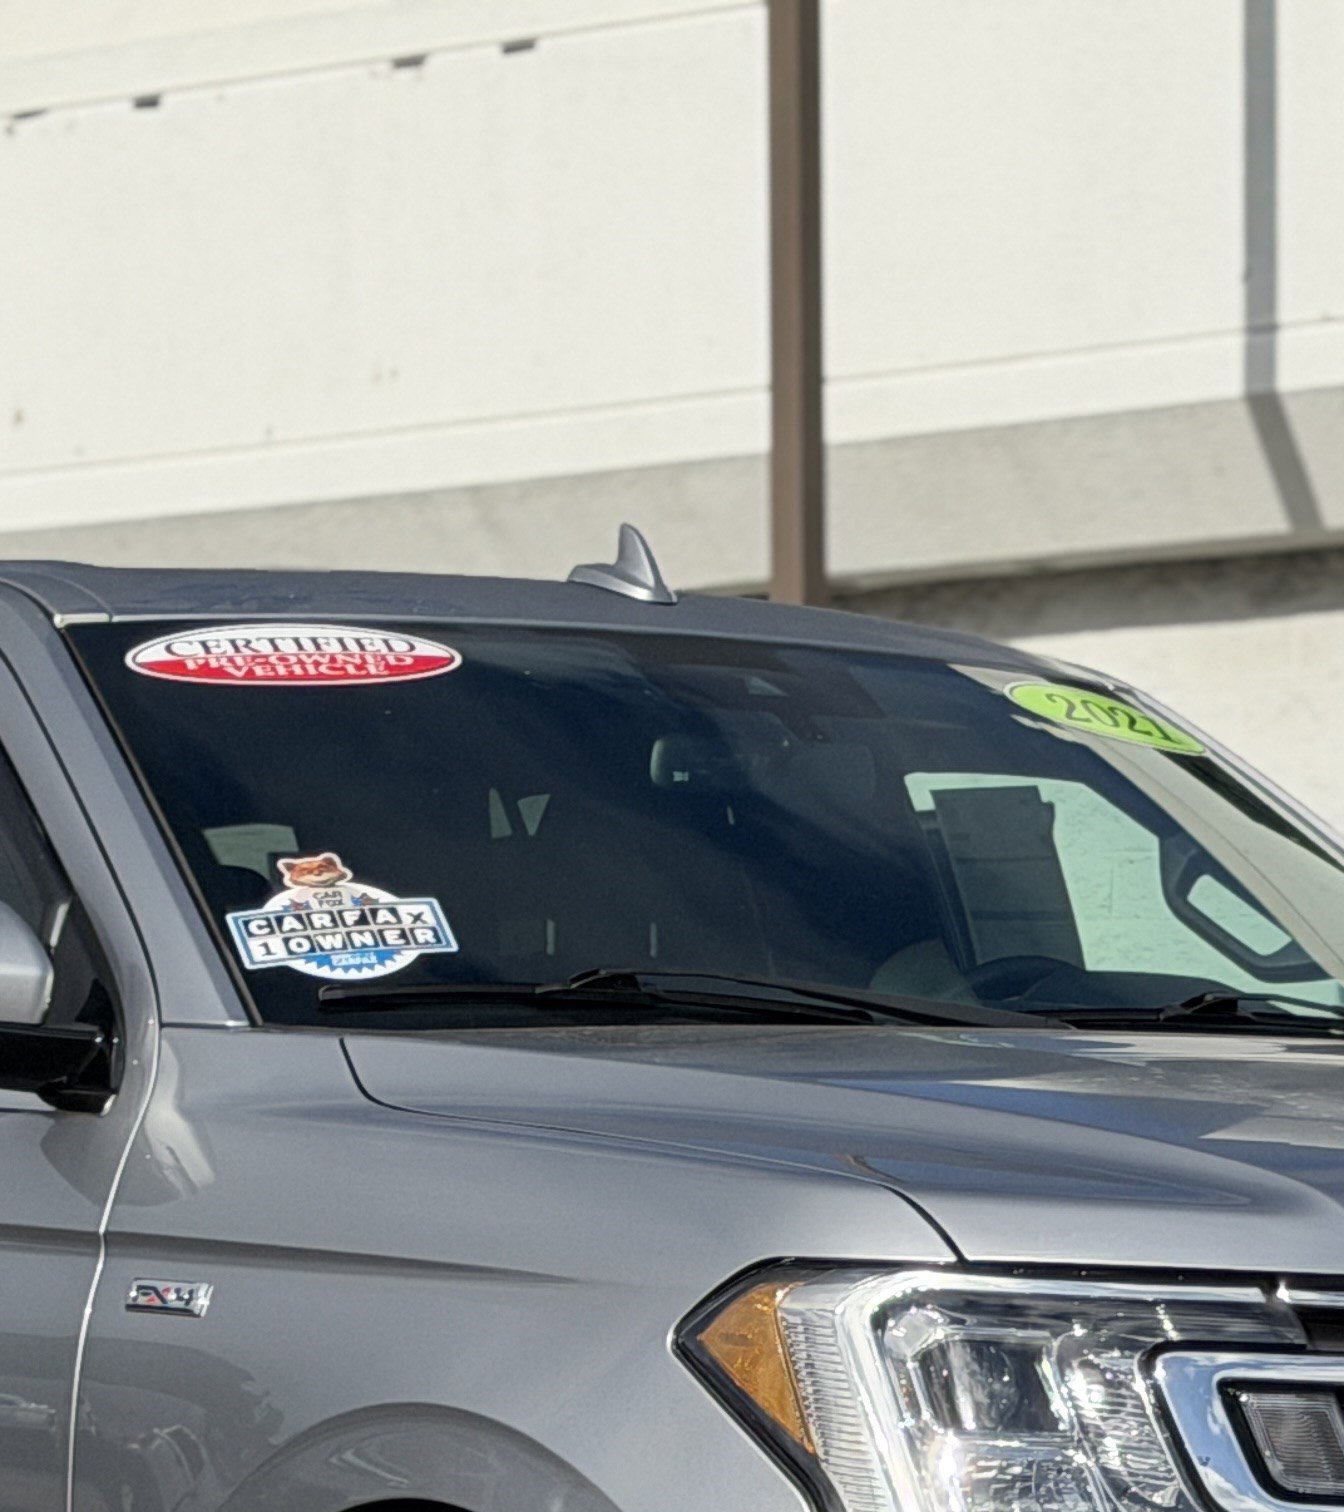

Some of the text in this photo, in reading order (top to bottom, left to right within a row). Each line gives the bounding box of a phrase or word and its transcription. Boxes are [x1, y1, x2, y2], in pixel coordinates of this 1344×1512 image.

[164, 636, 416, 657] CERTIFIED
[183, 653, 415, 671] PRE-OWNED
[223, 663, 391, 678] VEHICLE
[1044, 692, 1185, 746] 2021
[246, 907, 429, 937] CARFAX
[258, 928, 437, 957] 1 OWNER
